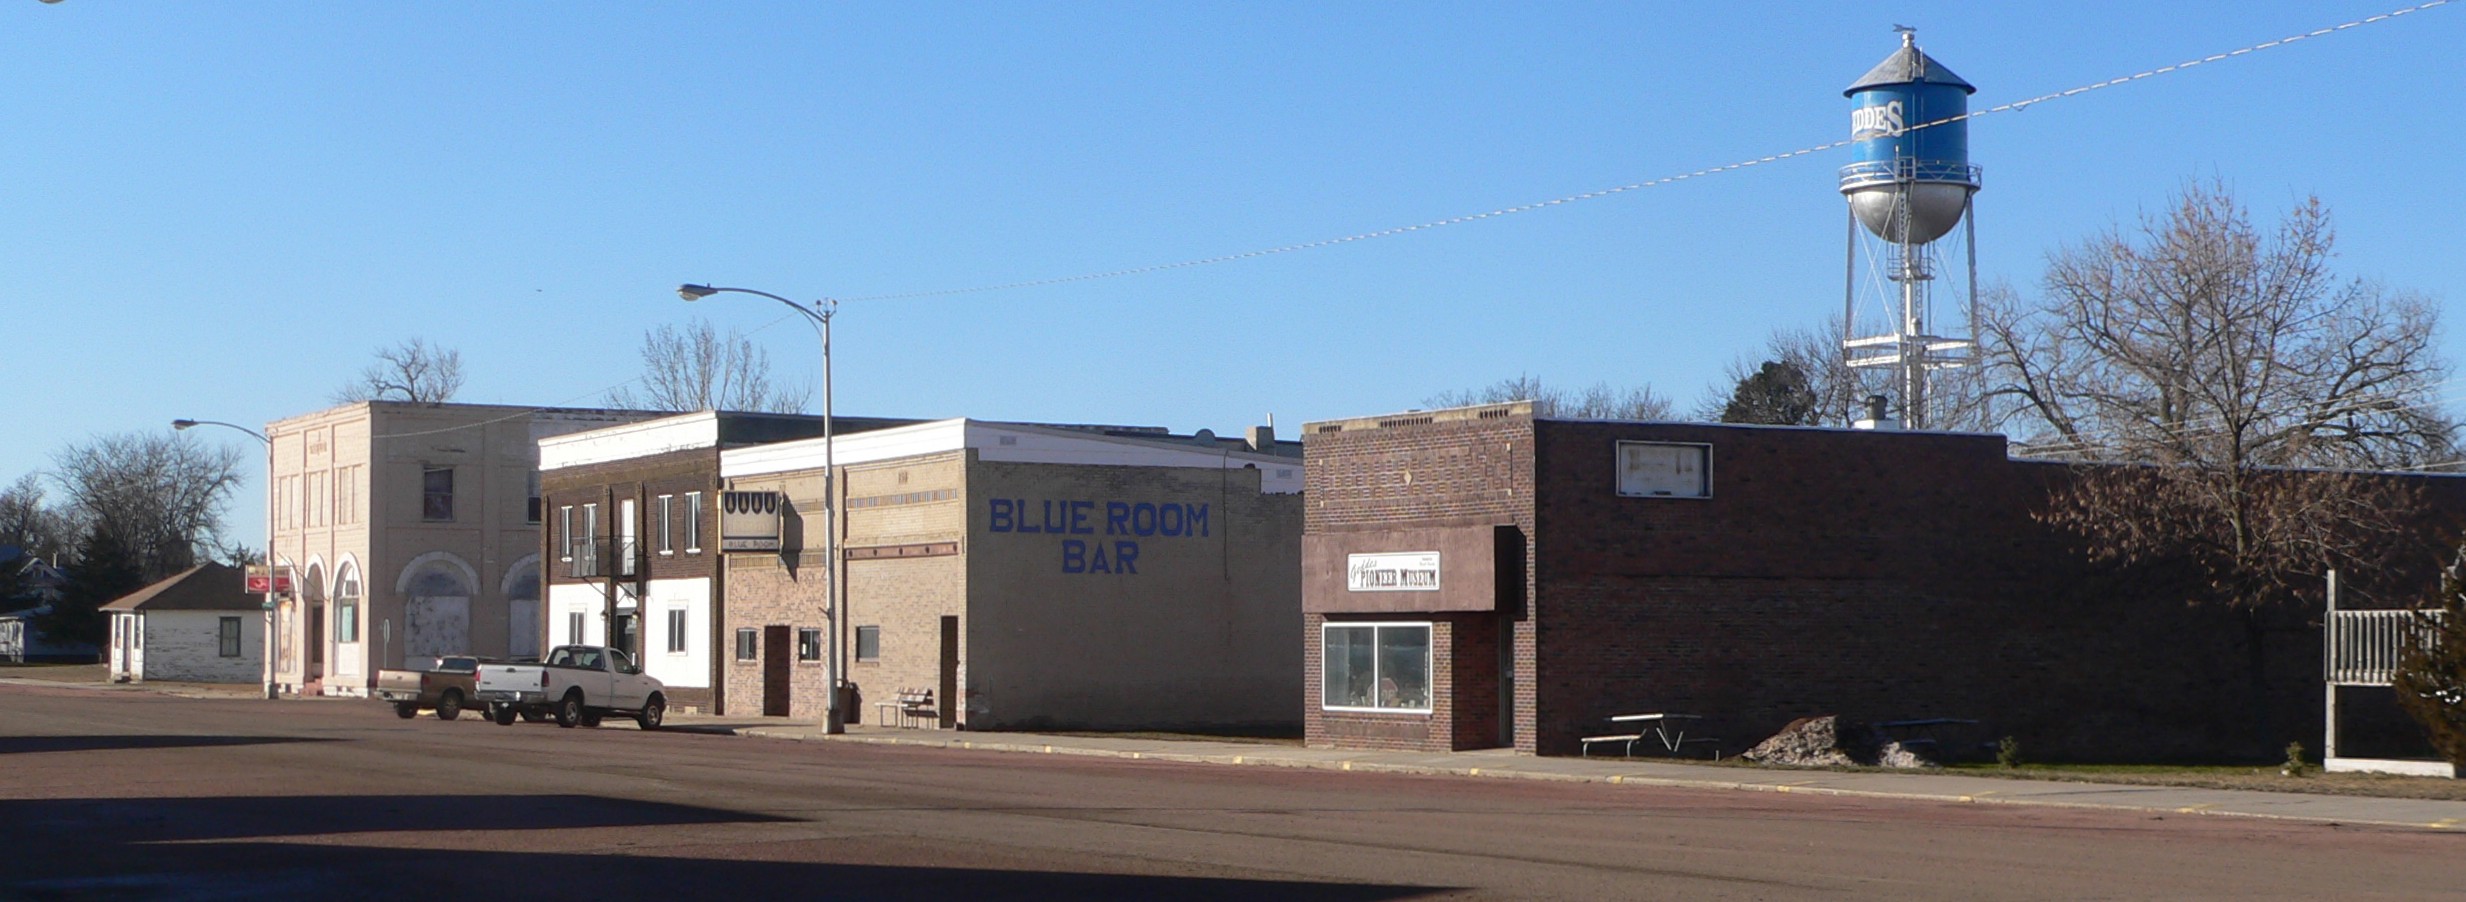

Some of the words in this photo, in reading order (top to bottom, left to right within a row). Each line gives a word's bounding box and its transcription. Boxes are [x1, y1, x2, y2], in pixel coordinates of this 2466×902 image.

[1852, 101, 1904, 138] DDES
[989, 499, 1095, 534] BLUE
[1106, 502, 1209, 537] ROOM
[1062, 539, 1139, 574] BAR
[1360, 569, 1397, 588] PIONEER
[1400, 568, 1437, 587] MUSEUM
